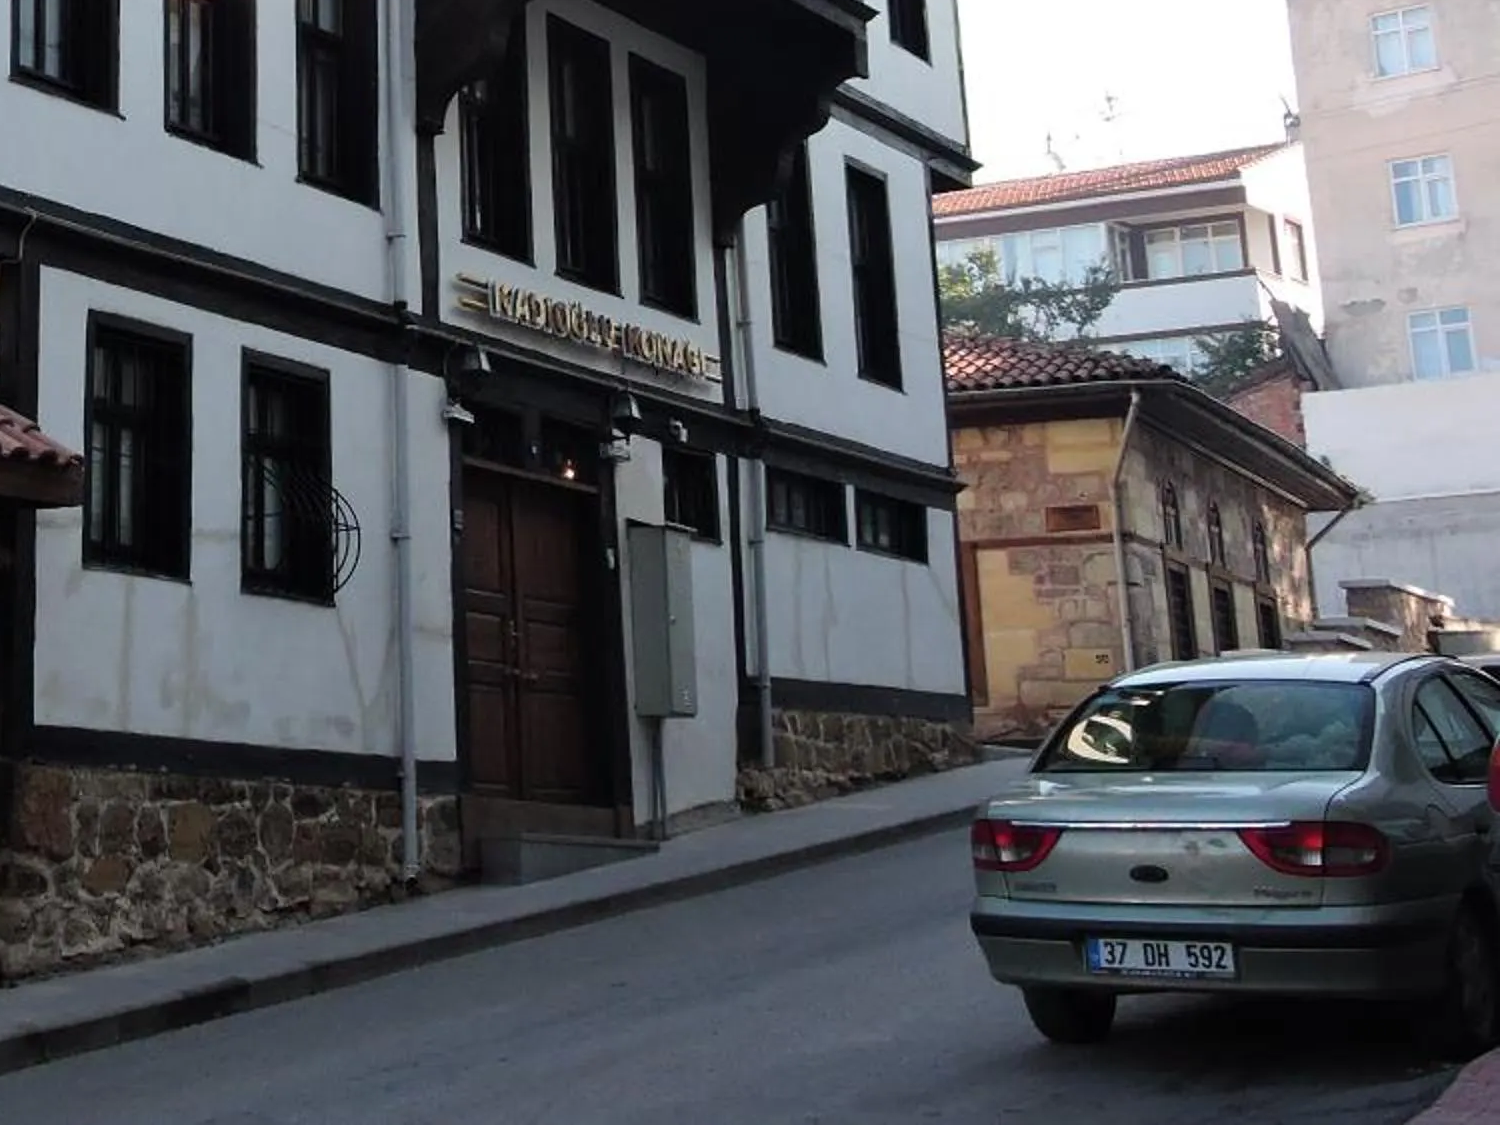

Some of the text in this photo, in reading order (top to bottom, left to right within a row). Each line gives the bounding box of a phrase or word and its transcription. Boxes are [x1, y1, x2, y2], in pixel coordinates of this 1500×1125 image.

[1103, 941, 1228, 969] 37 DH 592
